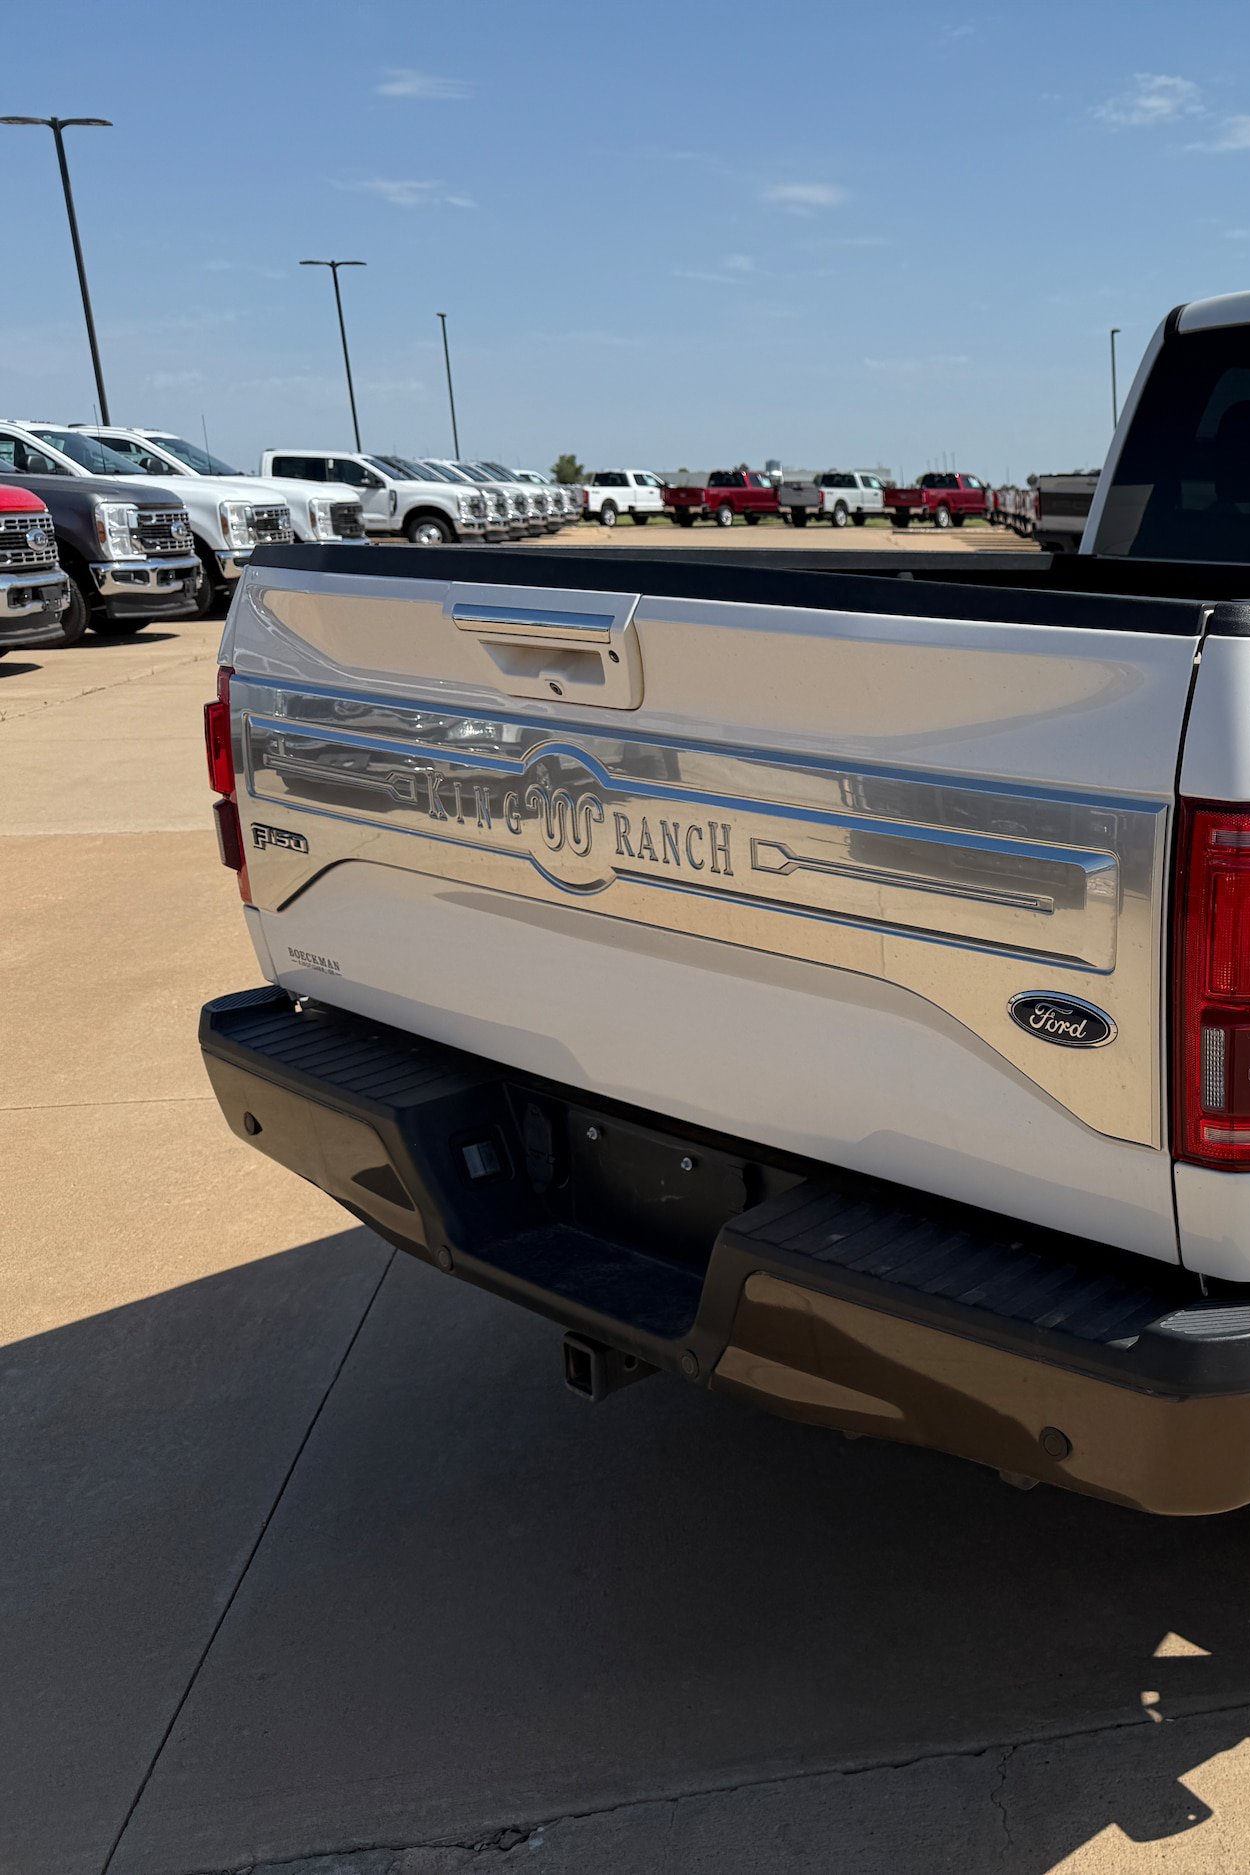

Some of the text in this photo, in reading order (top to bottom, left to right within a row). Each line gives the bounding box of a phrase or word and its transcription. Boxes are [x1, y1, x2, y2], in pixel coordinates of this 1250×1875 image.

[426, 771, 735, 877] KING RANCH
[287, 946, 341, 971] BOECKMAN
[1029, 1002, 1088, 1039] Ford
